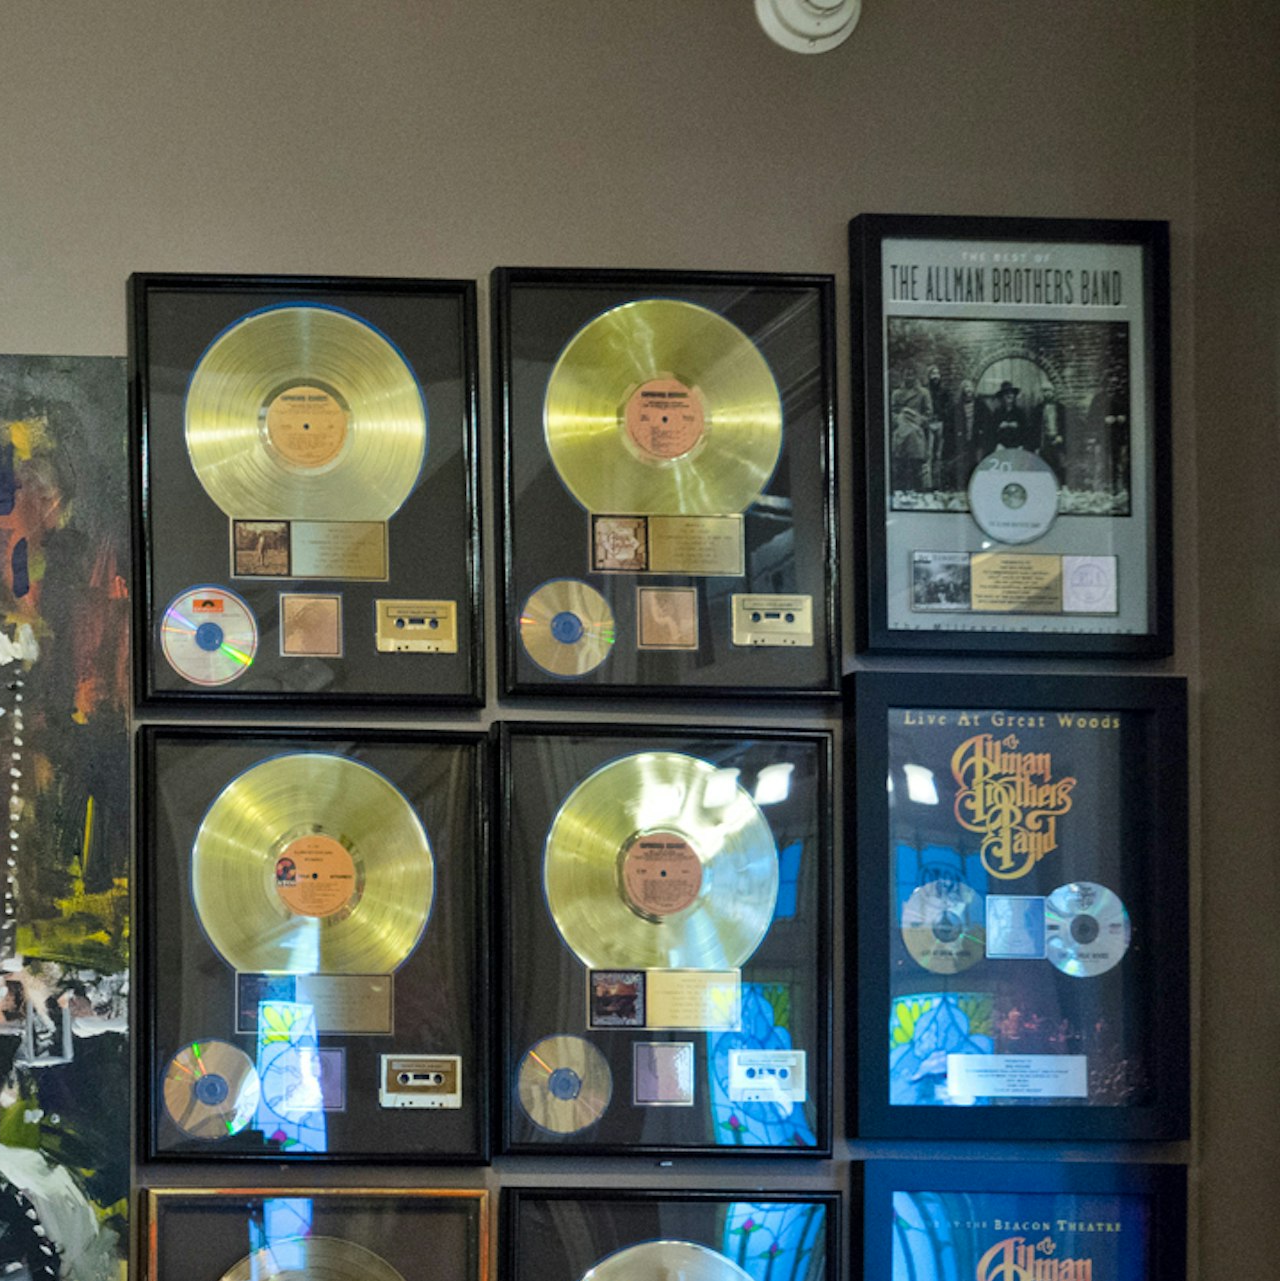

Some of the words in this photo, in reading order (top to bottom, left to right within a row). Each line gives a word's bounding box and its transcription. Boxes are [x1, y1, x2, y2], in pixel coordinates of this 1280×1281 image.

[889, 264, 920, 302] THE
[925, 265, 986, 303] ALLMAN
[991, 267, 1075, 305] BROTHERS
[1080, 269, 1124, 307] BAND
[904, 709, 947, 727] Live
[957, 711, 982, 727] At
[991, 711, 1047, 729] Great
[1057, 711, 1123, 731] Woods
[993, 1218, 1051, 1232] BEACON
[1056, 1218, 1122, 1233] THEATRE
